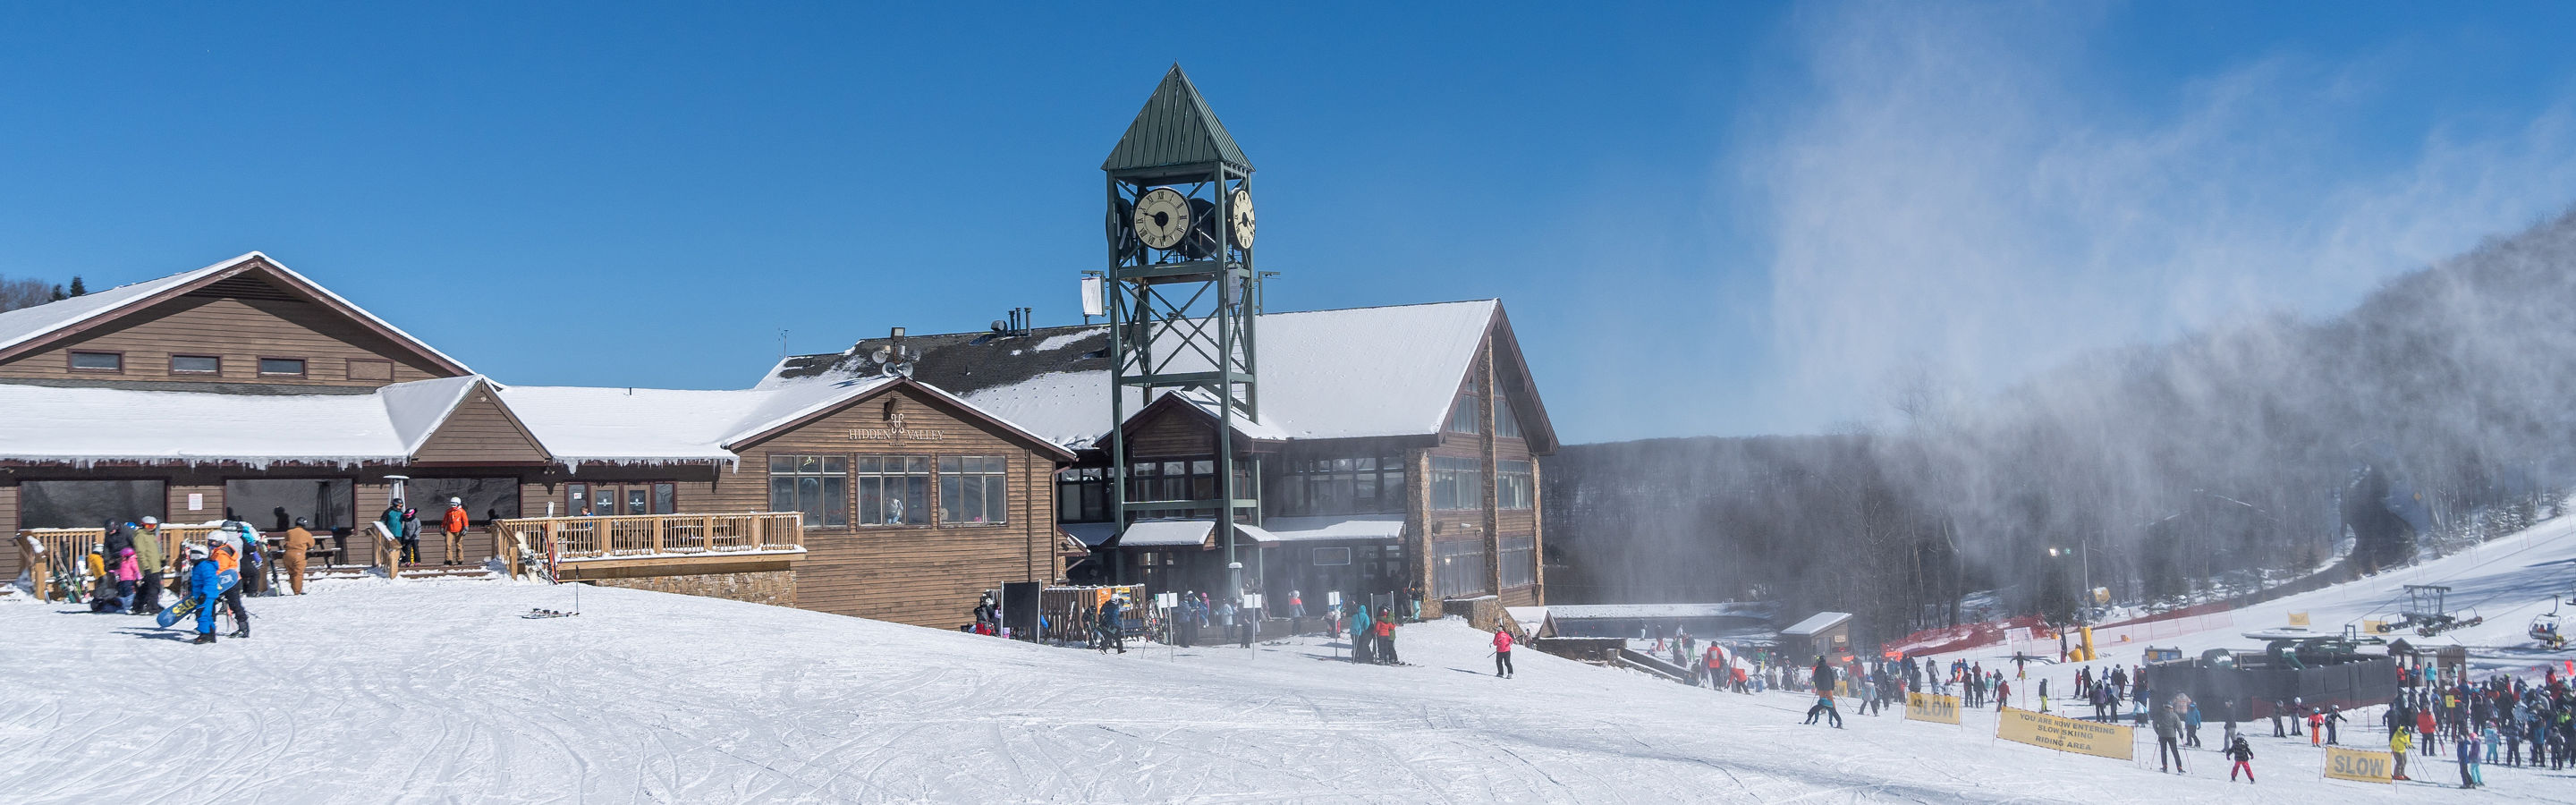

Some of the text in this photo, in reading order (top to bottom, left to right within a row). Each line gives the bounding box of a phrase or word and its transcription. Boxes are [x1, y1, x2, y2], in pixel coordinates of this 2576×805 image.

[849, 429, 945, 440] HIDDEN VALLEY
[1913, 699, 1954, 718] SLOW
[2020, 713, 2115, 734] YOU ARE NOW ENTERING
[2038, 724, 2060, 733] SLOW
[2062, 729, 2094, 739] SKIING
[2035, 735, 2064, 747] RIDING
[2066, 741, 2091, 750] AREA
[2334, 755, 2385, 776] SLOW
